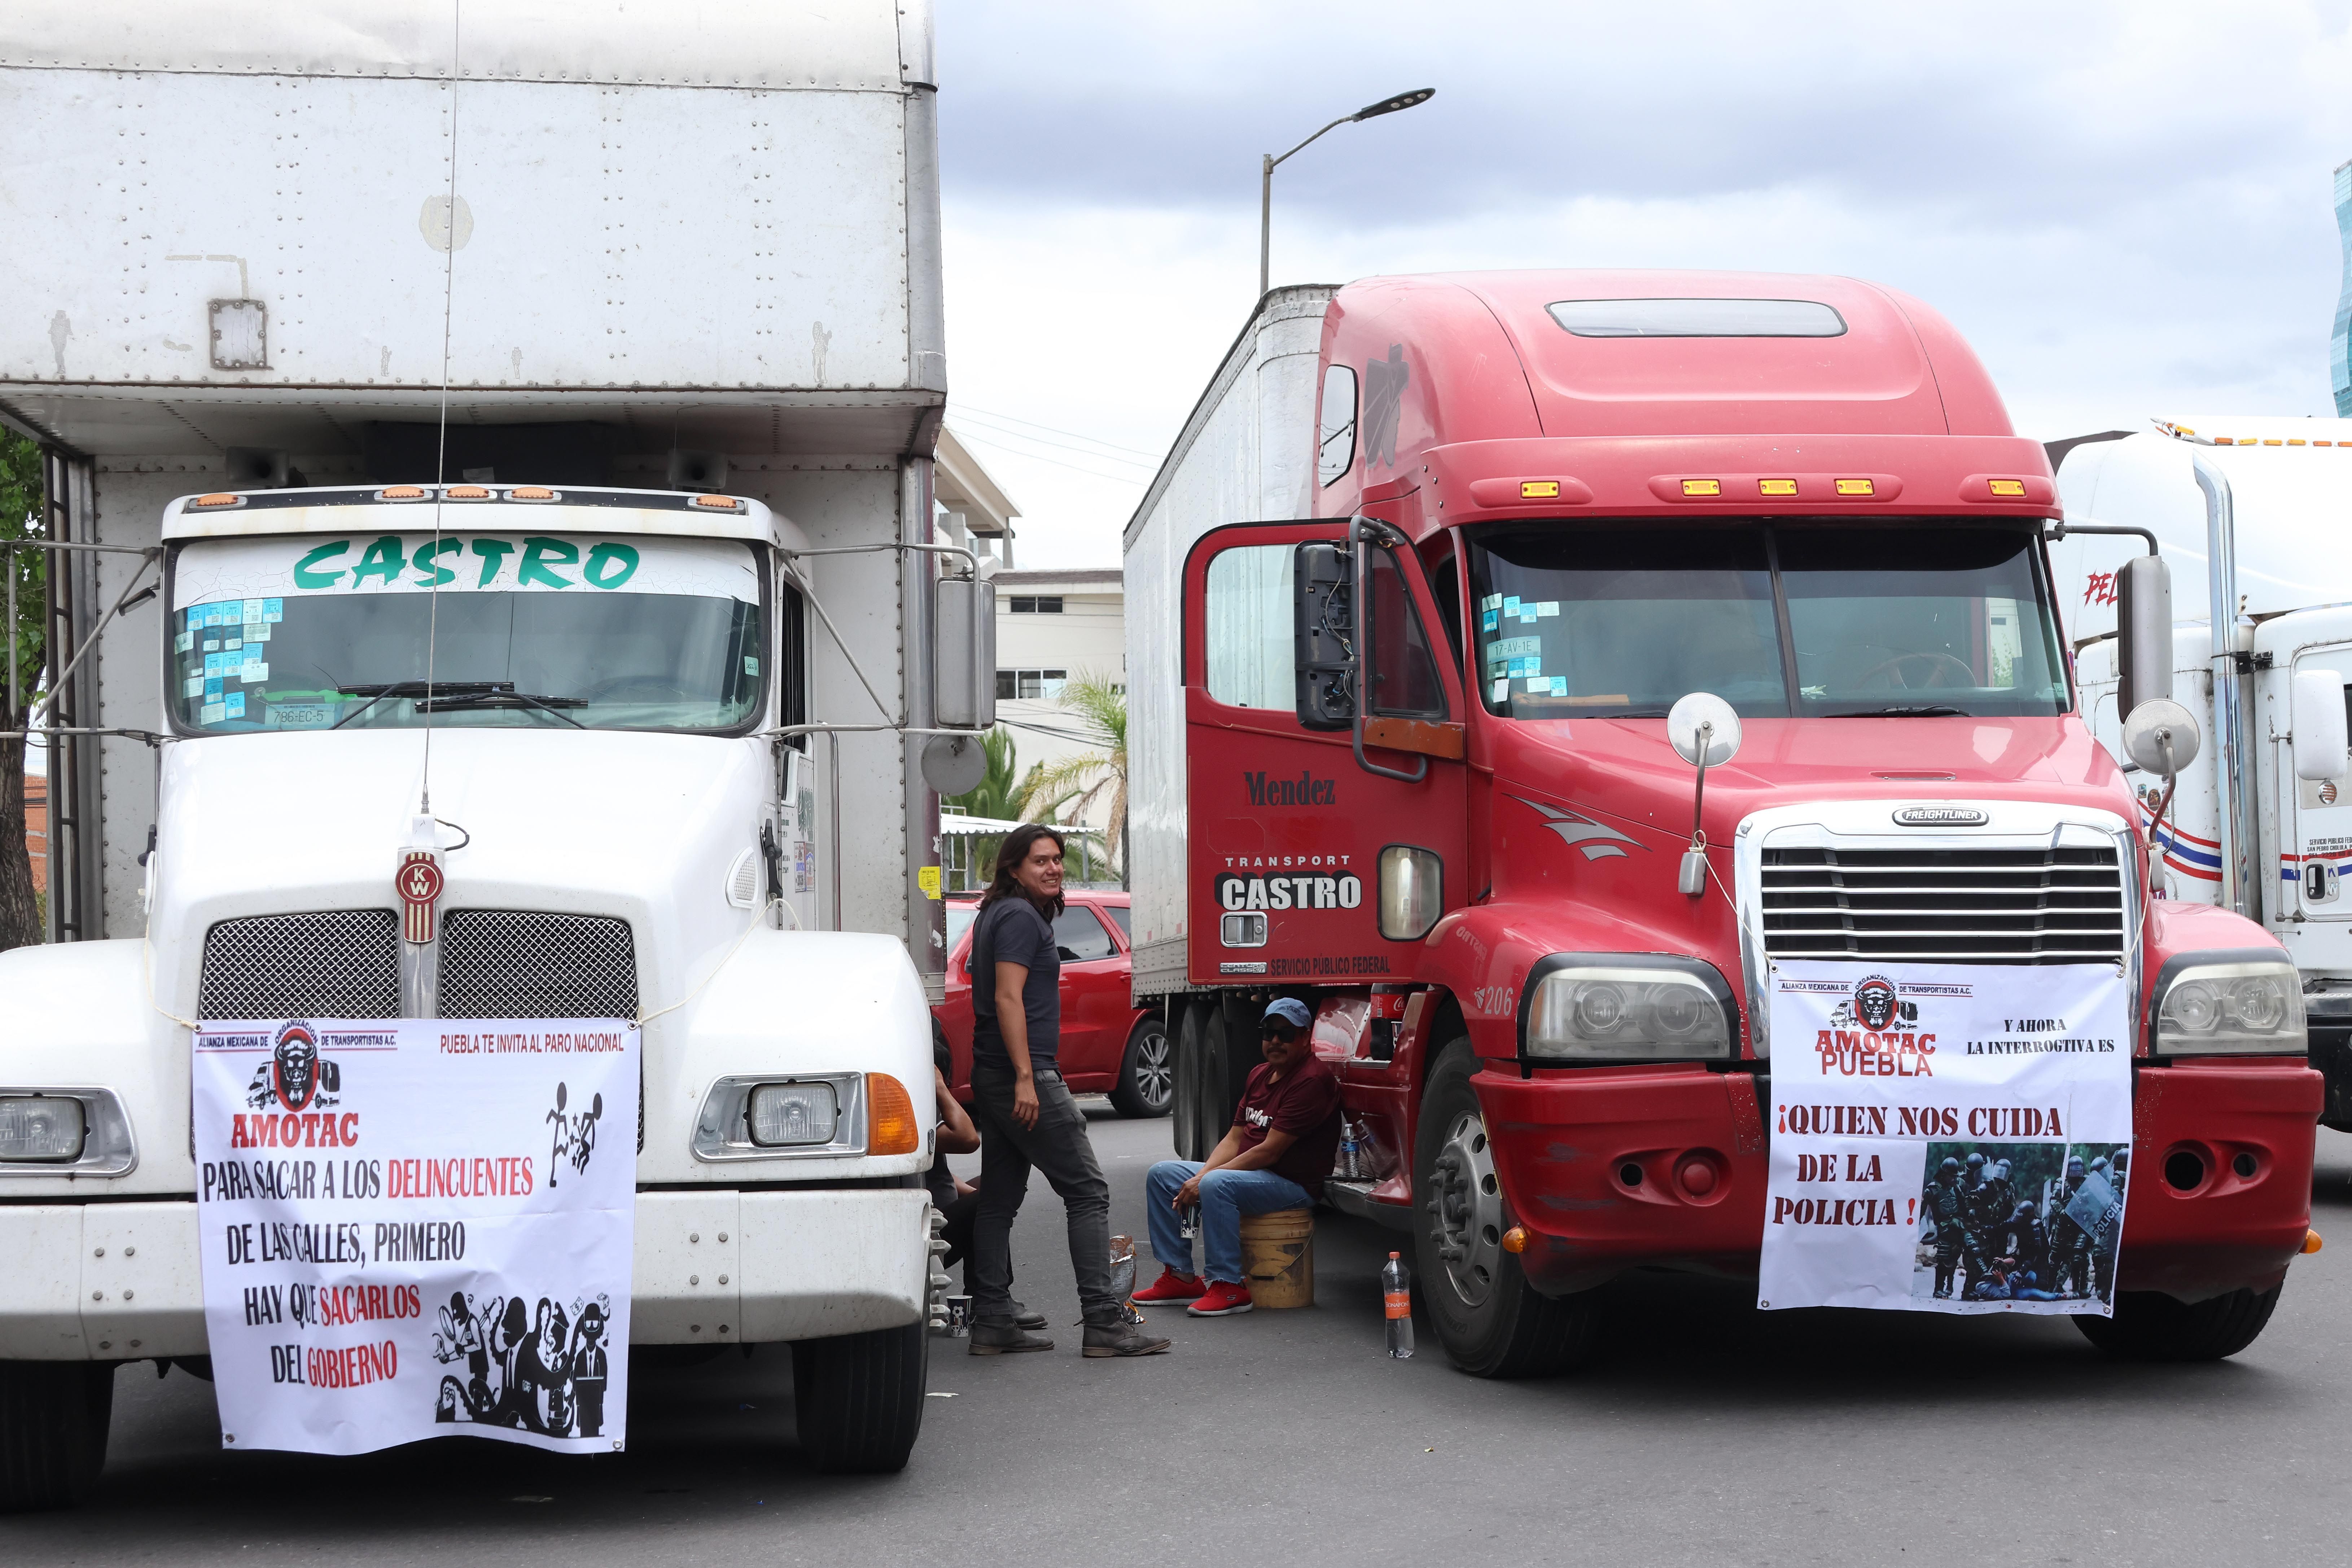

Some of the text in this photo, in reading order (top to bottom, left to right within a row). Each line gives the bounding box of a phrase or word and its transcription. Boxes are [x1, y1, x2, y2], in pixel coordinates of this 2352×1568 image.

[294, 535, 640, 589] CASTRO
[1495, 641, 1532, 656] 17-AV-1E
[273, 710, 324, 723] 786-EC-5
[1244, 771, 1336, 806] Mendez
[1905, 809, 1978, 820] FREIGHTLINER
[1225, 855, 1351, 867] TRANSPORT
[414, 868, 426, 881] K
[409, 882, 430, 895] W
[1220, 873, 1362, 910] CASTRO
[1271, 954, 1390, 976] SERVICIO PÚBLICO FEDERAL
[1781, 982, 1807, 991] ALIANZA
[1808, 984, 1839, 992] MEXICANA
[1855, 974, 1896, 991] ORGANIZACIÓN
[1909, 986, 1959, 995] TRANSPORTISTAS
[1485, 986, 1514, 1016] 206
[2004, 1019, 2067, 1033] Y AHORA
[199, 1036, 268, 1047] ALIANZA MEXICANA DE
[321, 1035, 396, 1046] DE TRANSPORTISTAS A.C.
[441, 1033, 624, 1054] PUEBLA TE INVITA AL PARO NACIONAL
[1815, 1030, 1936, 1056] AMOTAC
[1967, 1039, 2115, 1055] LA INTERROGTIVA ES
[1822, 1051, 1933, 1077] PUEBLA
[232, 1113, 359, 1148] AMOTAC
[1779, 1104, 2063, 1137] ¡QUIEN NOS CUIDA
[203, 1157, 533, 1202] PARA SACAR A LOS DELINCUENTES
[1797, 1154, 1883, 1182] DE LA
[1773, 1197, 1896, 1226] POLICIA
[2093, 1201, 2122, 1237] POLICIA
[228, 1221, 465, 1269] DE LAS CALLES, PRIMERO
[245, 1283, 420, 1329] HAY QUE SACARLOS
[271, 1340, 397, 1388] DEL GOBIERNO
